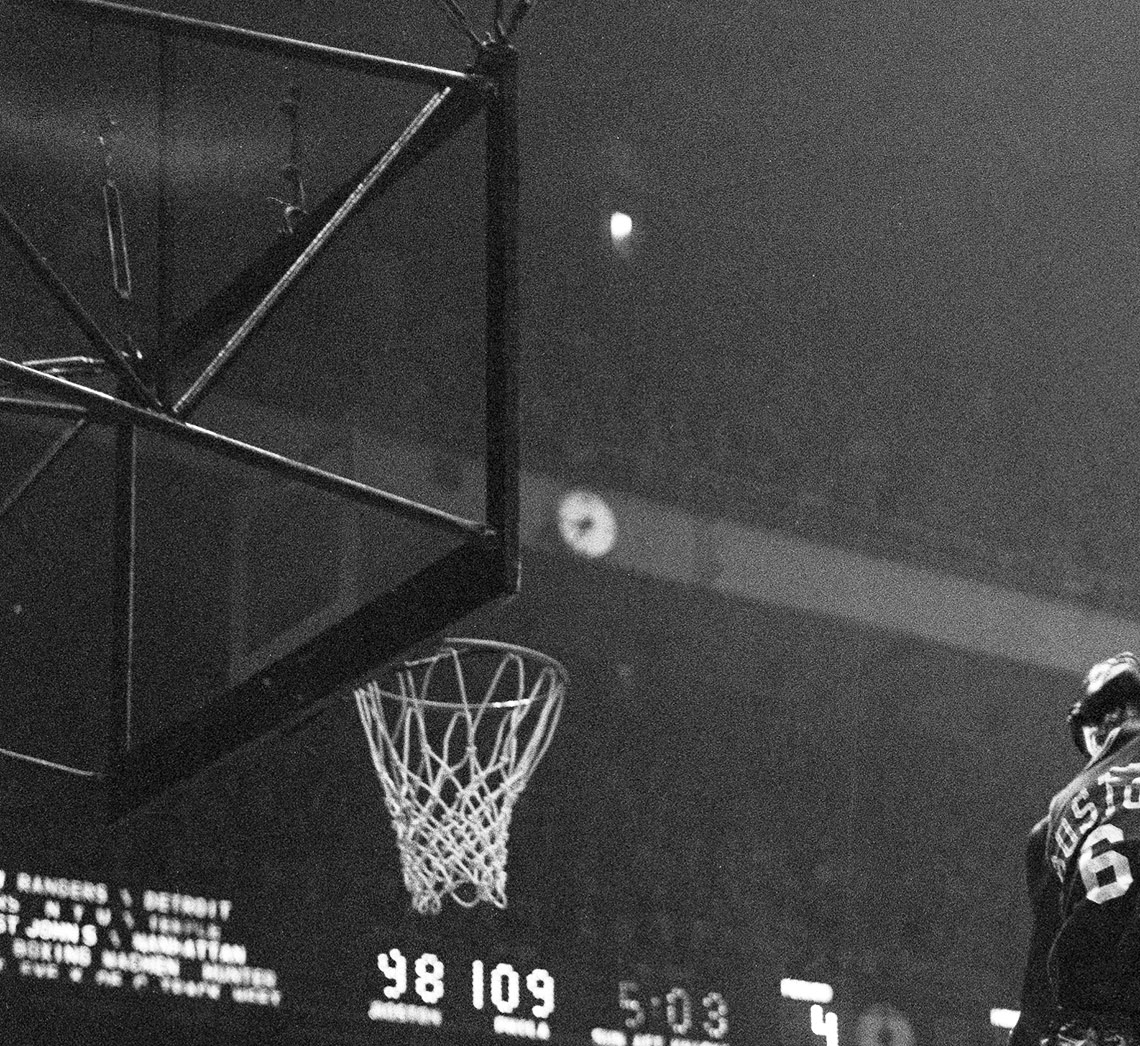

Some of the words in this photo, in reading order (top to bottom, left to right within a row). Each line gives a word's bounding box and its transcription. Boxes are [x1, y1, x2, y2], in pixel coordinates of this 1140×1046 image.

[1078, 823, 1134, 905] 6
[143, 890, 232, 921] DETROIT
[376, 948, 445, 1005] 98
[471, 960, 556, 1019] 109
[618, 980, 729, 1039] 5:03
